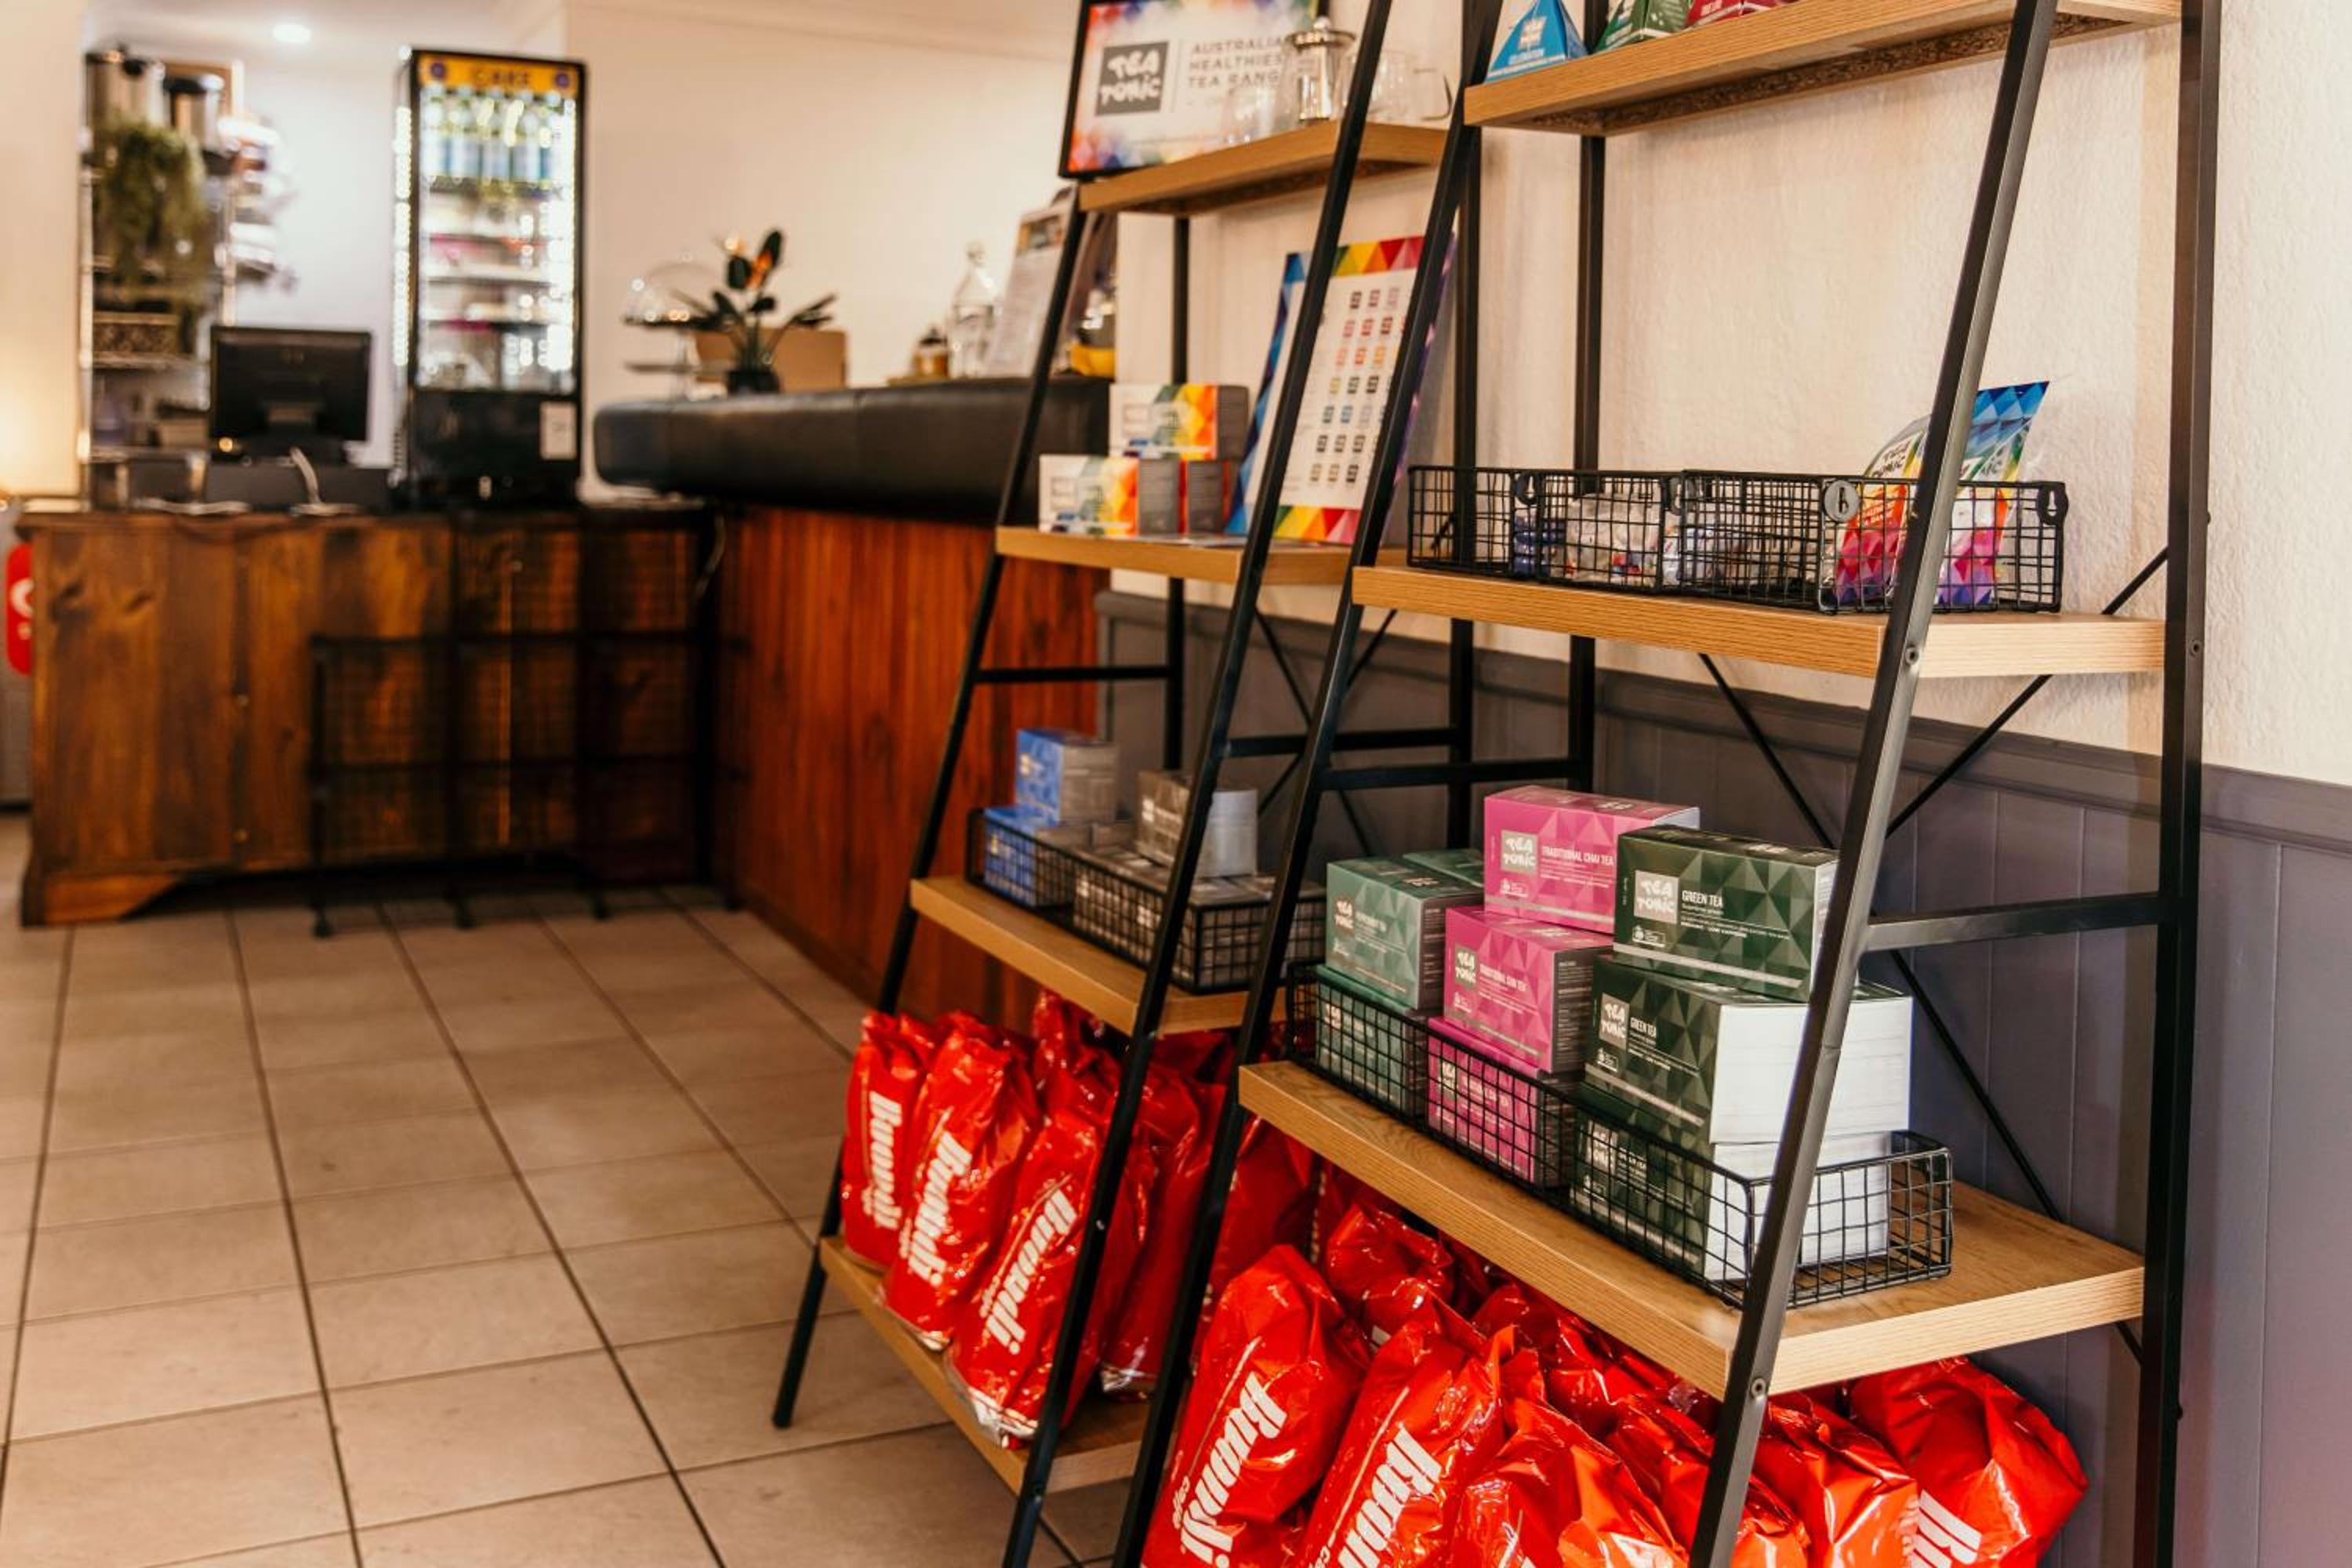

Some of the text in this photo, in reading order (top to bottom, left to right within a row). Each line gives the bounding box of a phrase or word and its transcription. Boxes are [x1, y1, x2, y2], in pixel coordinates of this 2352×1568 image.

[1107, 49, 1160, 79] TEA
[1505, 837, 1534, 852] TEA
[1600, 855, 1614, 866] TEA
[1640, 879, 1672, 898] TEA
[1682, 890, 1723, 908] GREEN TEA
[1605, 1004, 1625, 1022] TEA
[985, 1188, 1078, 1355] Buondi
[1180, 1370, 1288, 1568] Buondi
[1338, 1427, 1443, 1568] Buon
